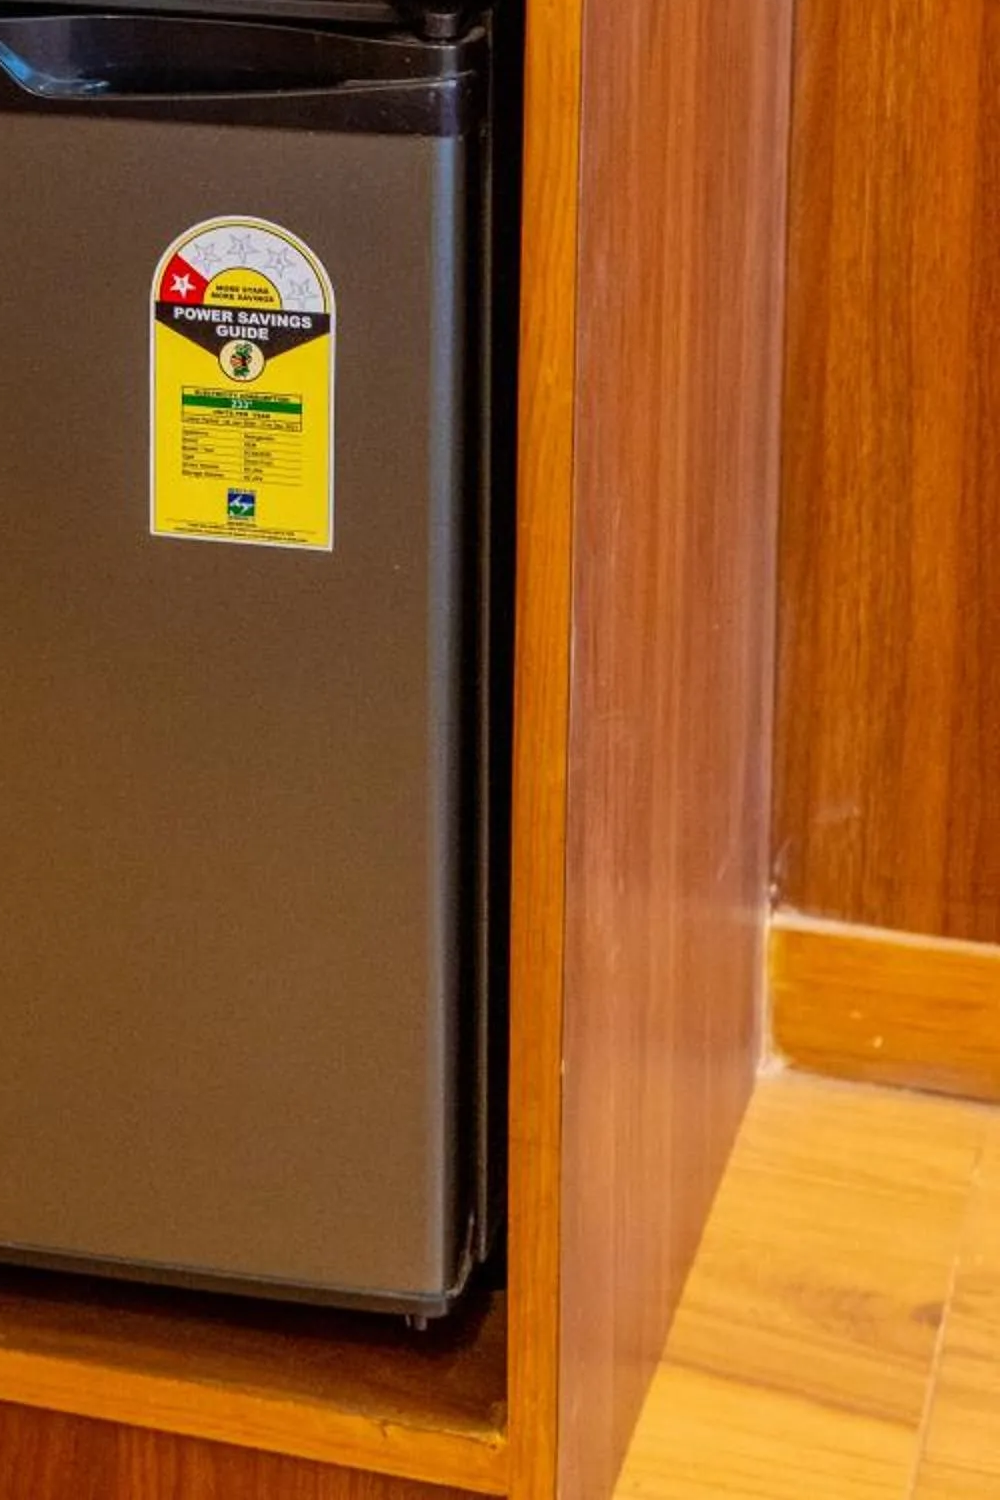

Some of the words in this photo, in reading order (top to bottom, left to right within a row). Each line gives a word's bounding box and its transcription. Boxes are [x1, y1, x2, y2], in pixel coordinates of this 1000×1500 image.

[173, 306, 234, 324] POWER
[237, 310, 312, 329] SAVINGS
[216, 324, 269, 341] GUIDE
